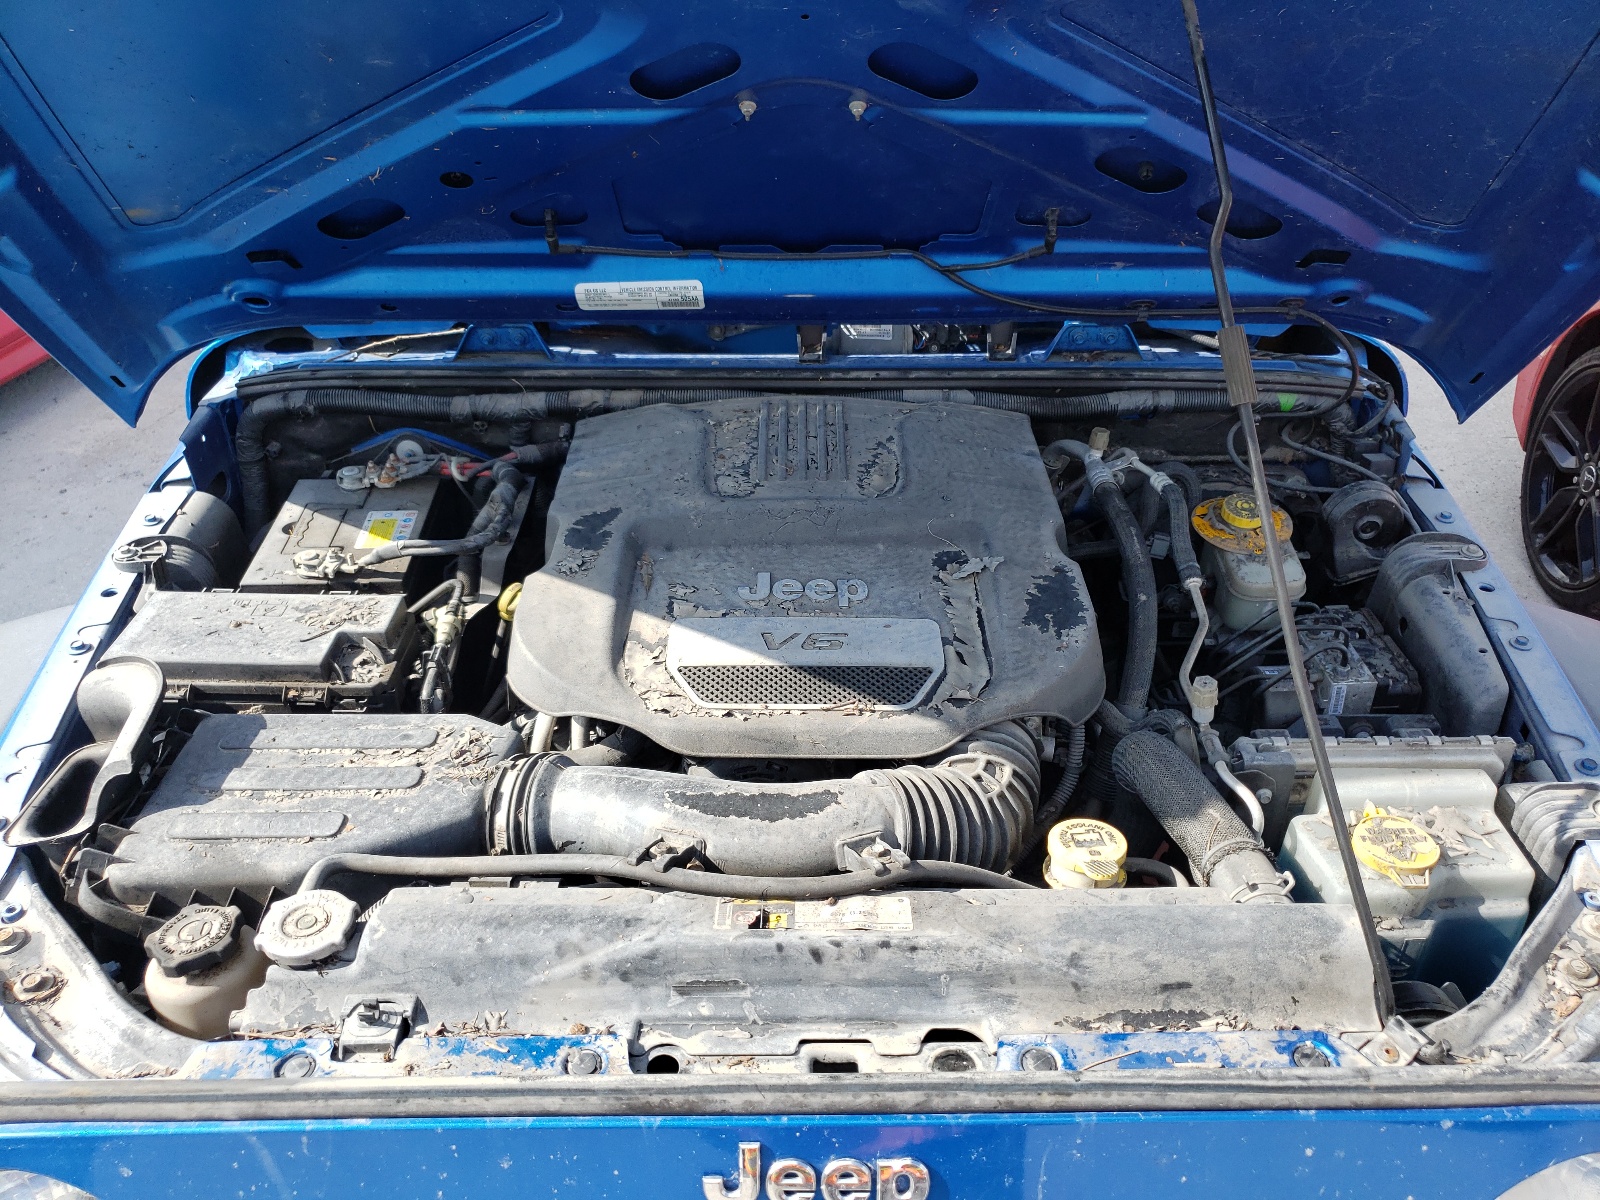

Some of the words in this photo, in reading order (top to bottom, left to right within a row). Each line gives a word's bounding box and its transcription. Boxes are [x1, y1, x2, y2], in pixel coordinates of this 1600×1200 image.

[737, 571, 869, 608] Jeep
[760, 631, 849, 651] V6
[702, 1142, 931, 1200] Jeep
